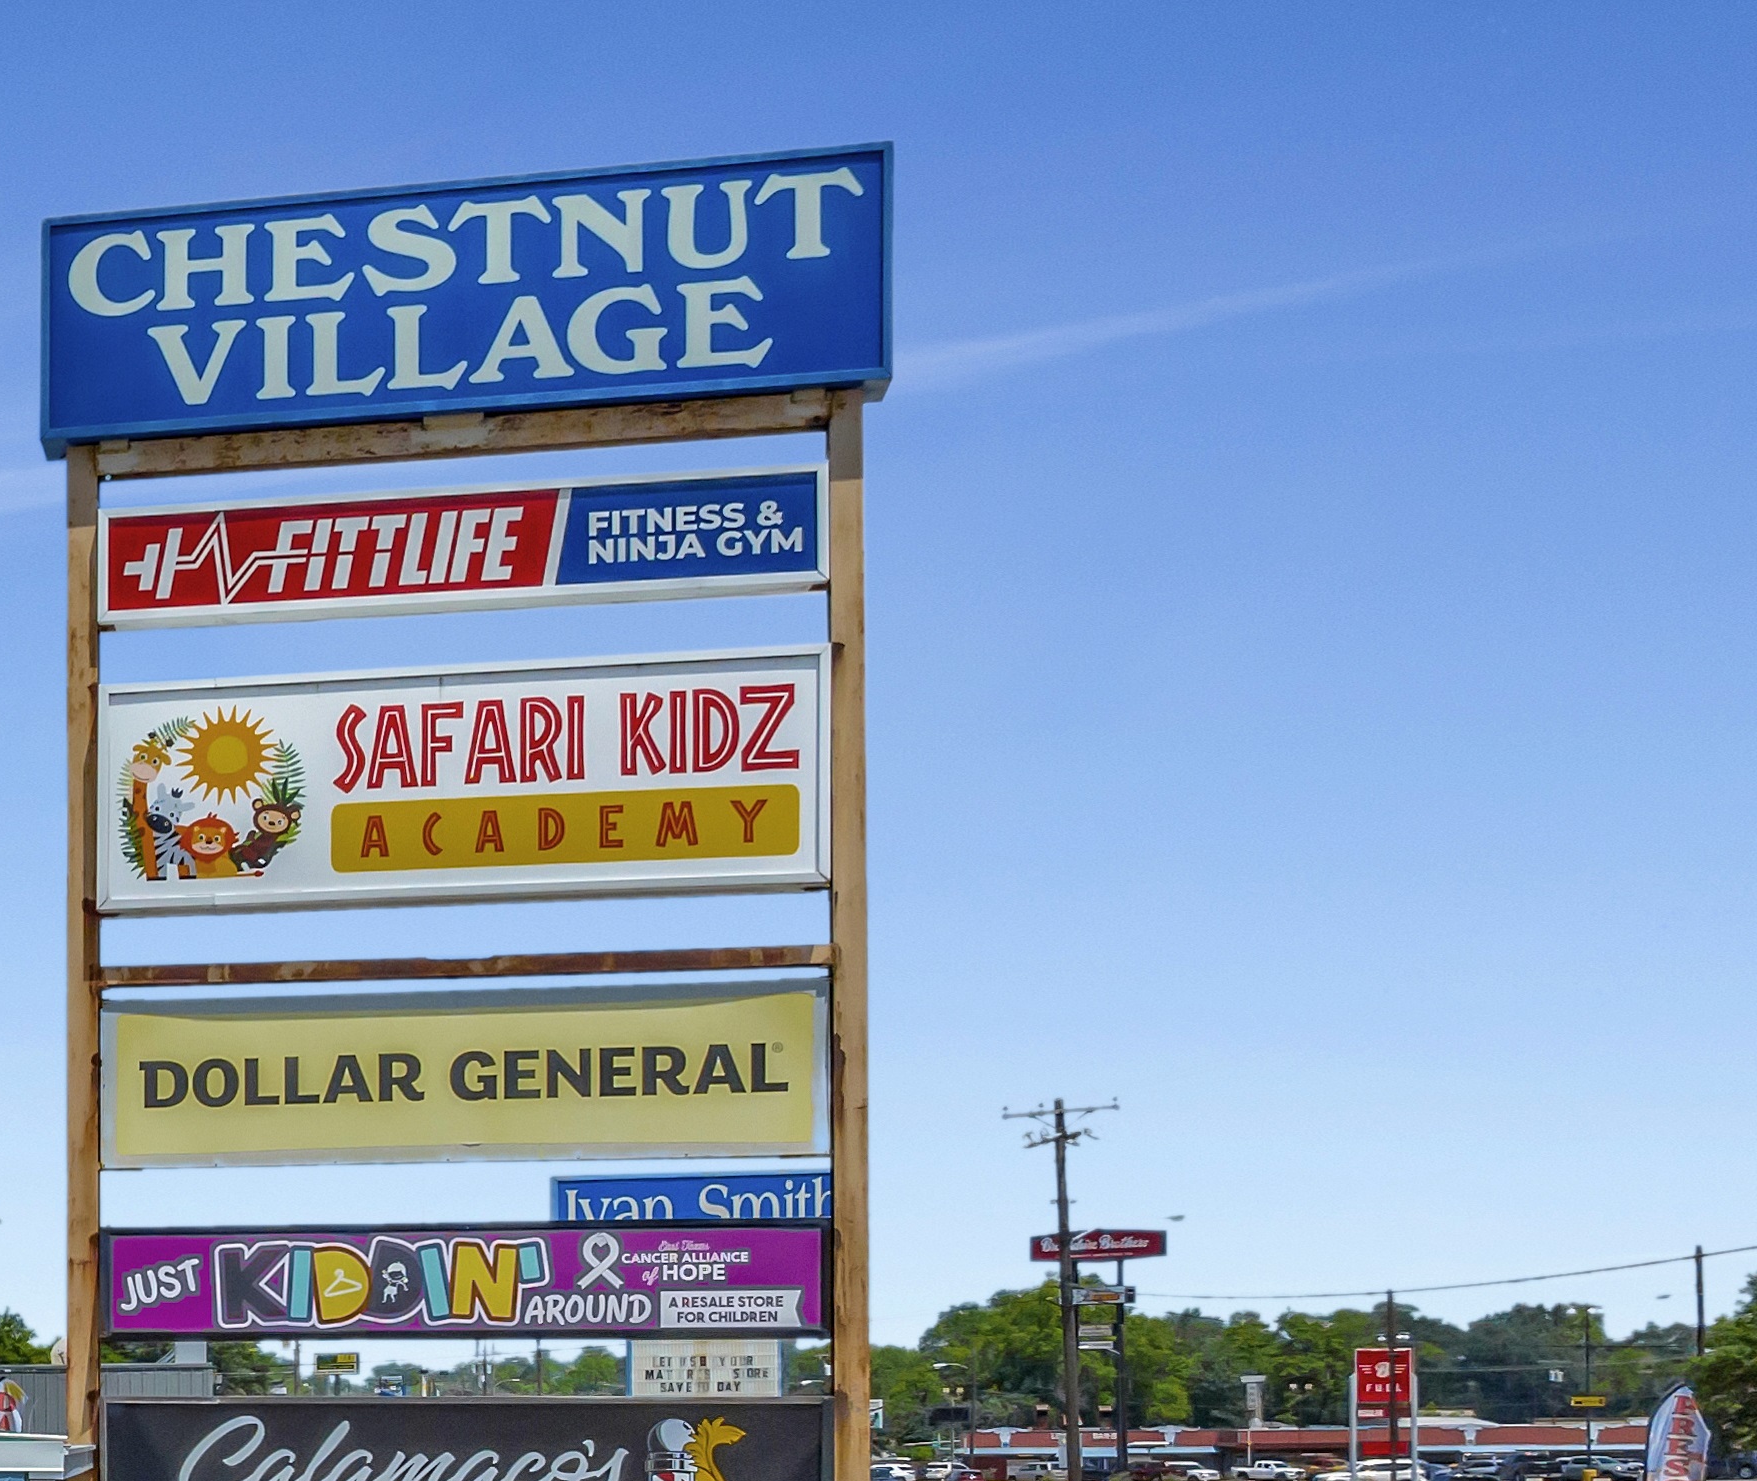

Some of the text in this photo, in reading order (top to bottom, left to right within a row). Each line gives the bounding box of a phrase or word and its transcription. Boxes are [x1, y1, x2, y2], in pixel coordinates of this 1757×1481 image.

[67, 167, 864, 317] CHESTNUT
[147, 275, 774, 405] VILLAGE
[588, 500, 783, 537] FITNESS &
[268, 506, 524, 594] FITTLIFE
[588, 527, 803, 564] NINJA GYM
[333, 682, 800, 793] SAFARI KIDZ
[361, 799, 768, 858] ACADEMY
[139, 1041, 789, 1109] DOLLAR GENERAL
[565, 1176, 831, 1220] Ivan Smith
[621, 1252, 749, 1264] CANCER ALLIANCE
[642, 1264, 726, 1286] of HOPE
[120, 1258, 200, 1311] JUST
[669, 1295, 784, 1308] A RESALE STORE
[525, 1293, 652, 1325] AROUND
[677, 1311, 778, 1323] FOR CHILDREN
[660, 1382, 692, 1393] SAVE
[716, 1381, 742, 1393] DAY
